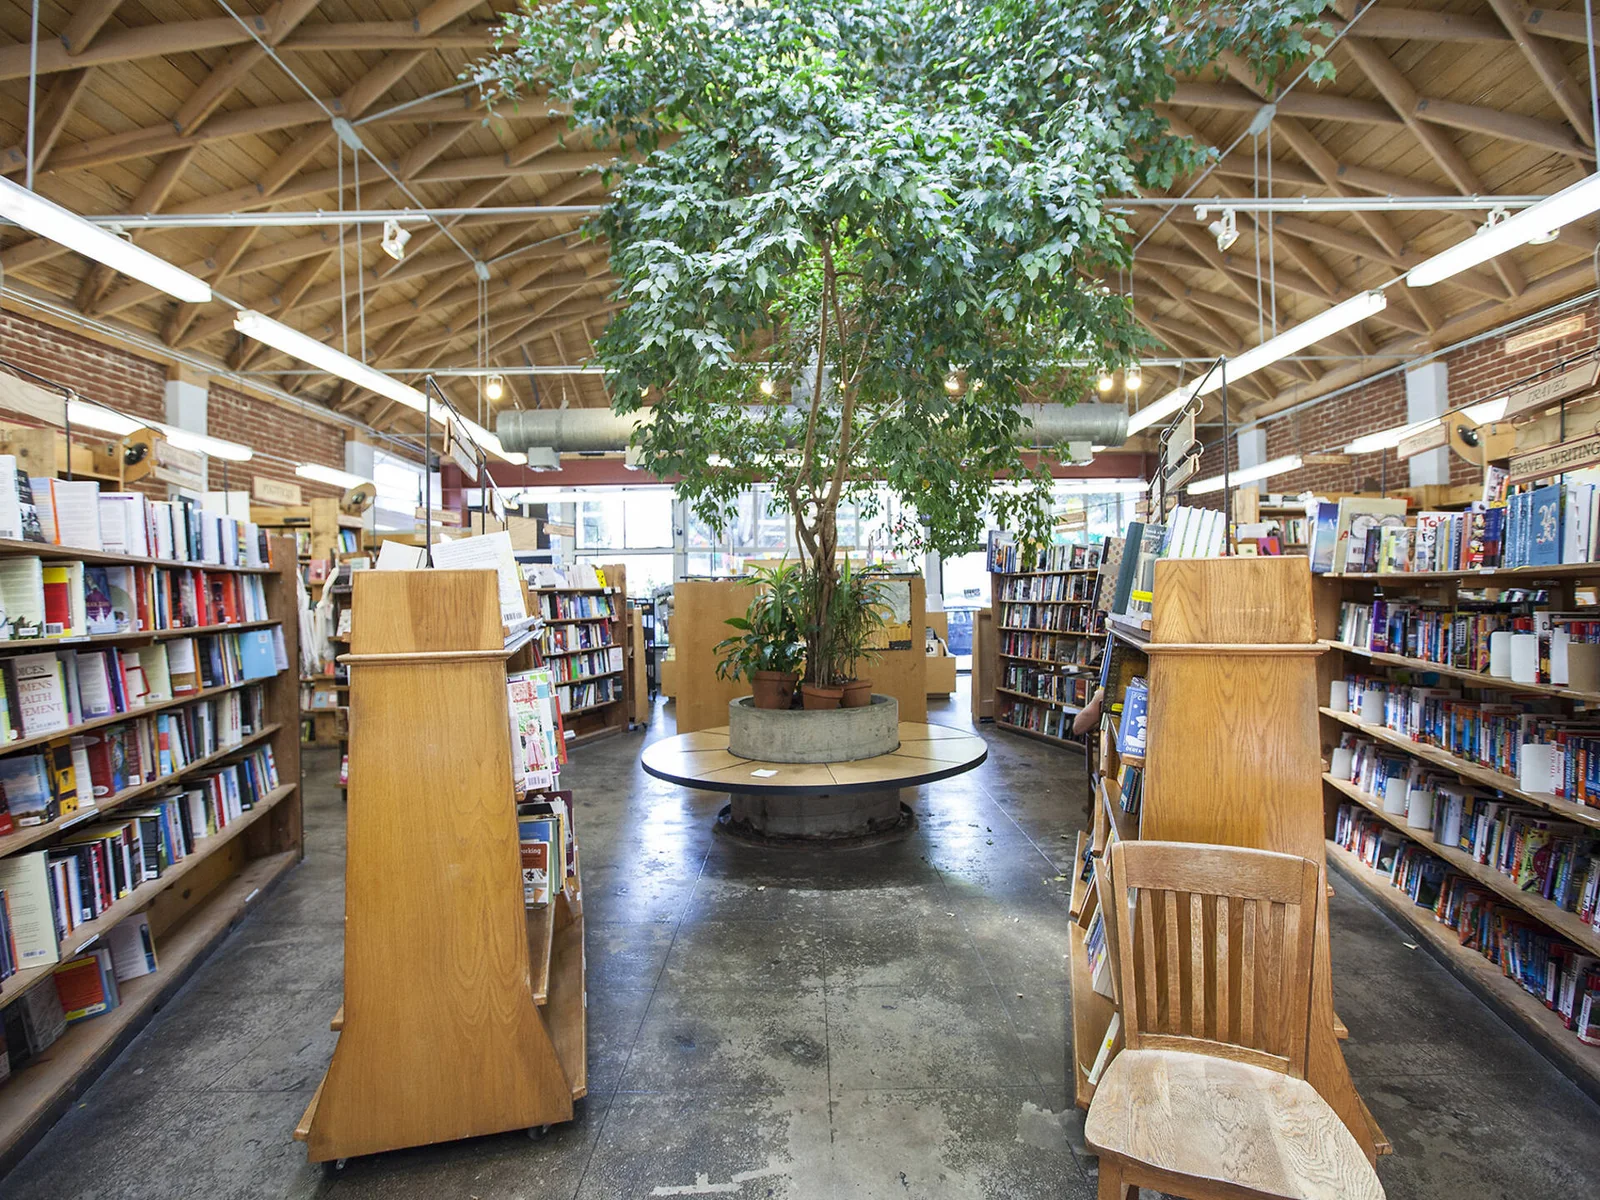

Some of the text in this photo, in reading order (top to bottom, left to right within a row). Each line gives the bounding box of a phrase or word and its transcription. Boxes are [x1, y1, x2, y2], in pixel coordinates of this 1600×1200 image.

[1526, 377, 1567, 403] TRAVEL
[1511, 441, 1600, 476] TRAVEL WRITING
